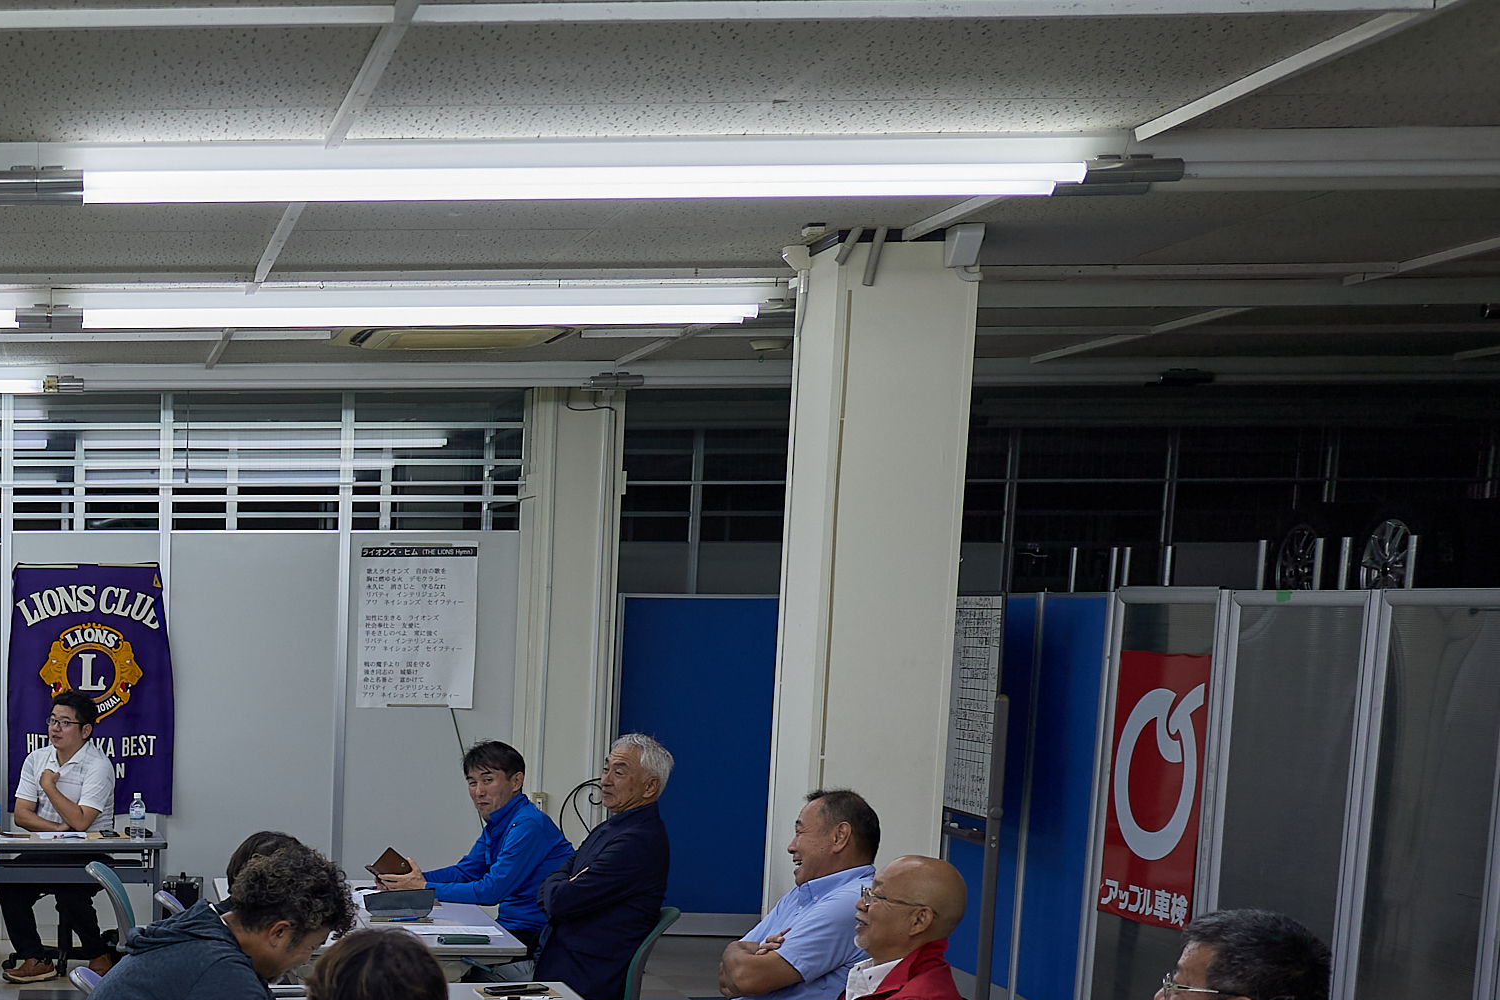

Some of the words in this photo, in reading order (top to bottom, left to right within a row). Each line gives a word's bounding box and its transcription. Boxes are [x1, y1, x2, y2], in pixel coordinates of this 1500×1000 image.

[15, 585, 96, 627] LIONS
[64, 628, 118, 648] LIONS
[78, 653, 107, 691] L
[122, 735, 157, 757] BEST
[1101, 879, 1188, 927] アップル車検
